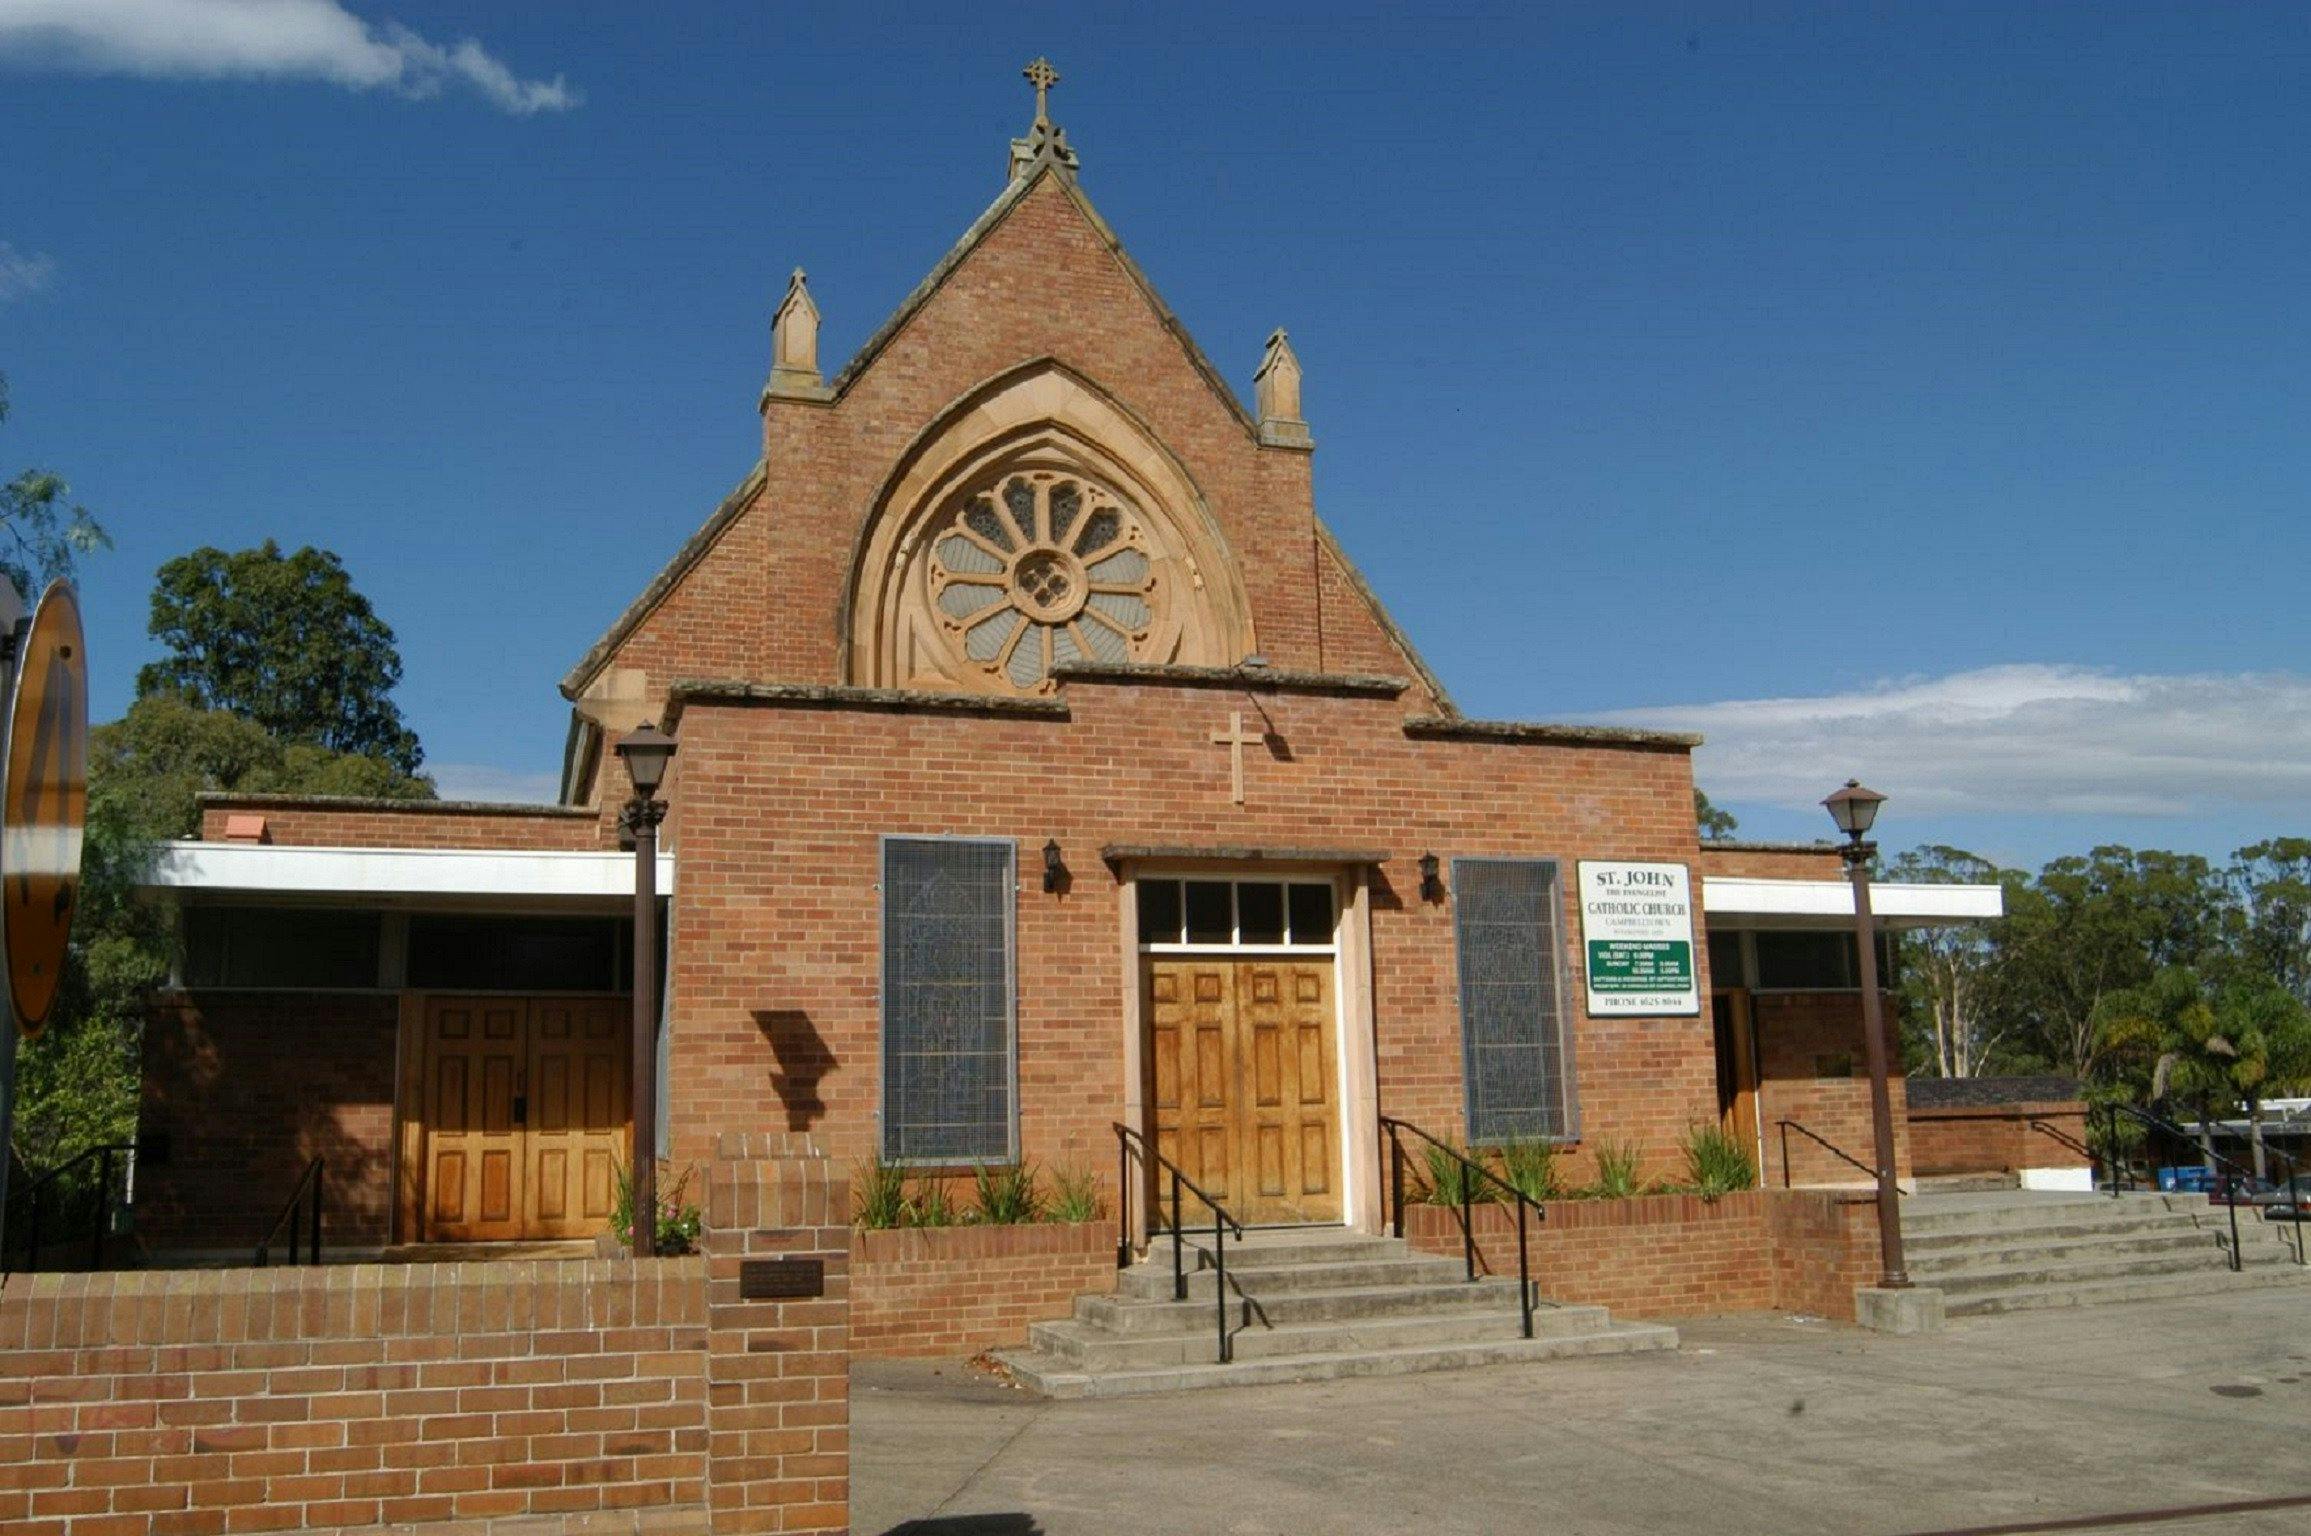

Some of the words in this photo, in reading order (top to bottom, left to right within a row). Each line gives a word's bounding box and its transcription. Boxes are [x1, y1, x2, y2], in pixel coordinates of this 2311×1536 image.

[1597, 871, 1620, 886] ST.
[1624, 871, 1674, 887] JOHN
[1623, 889, 1666, 897] EVANGELIST
[1588, 902, 1639, 915] CATHOLIC
[1642, 902, 1686, 916] CHURCH
[1605, 998, 1635, 1006] PHONE
